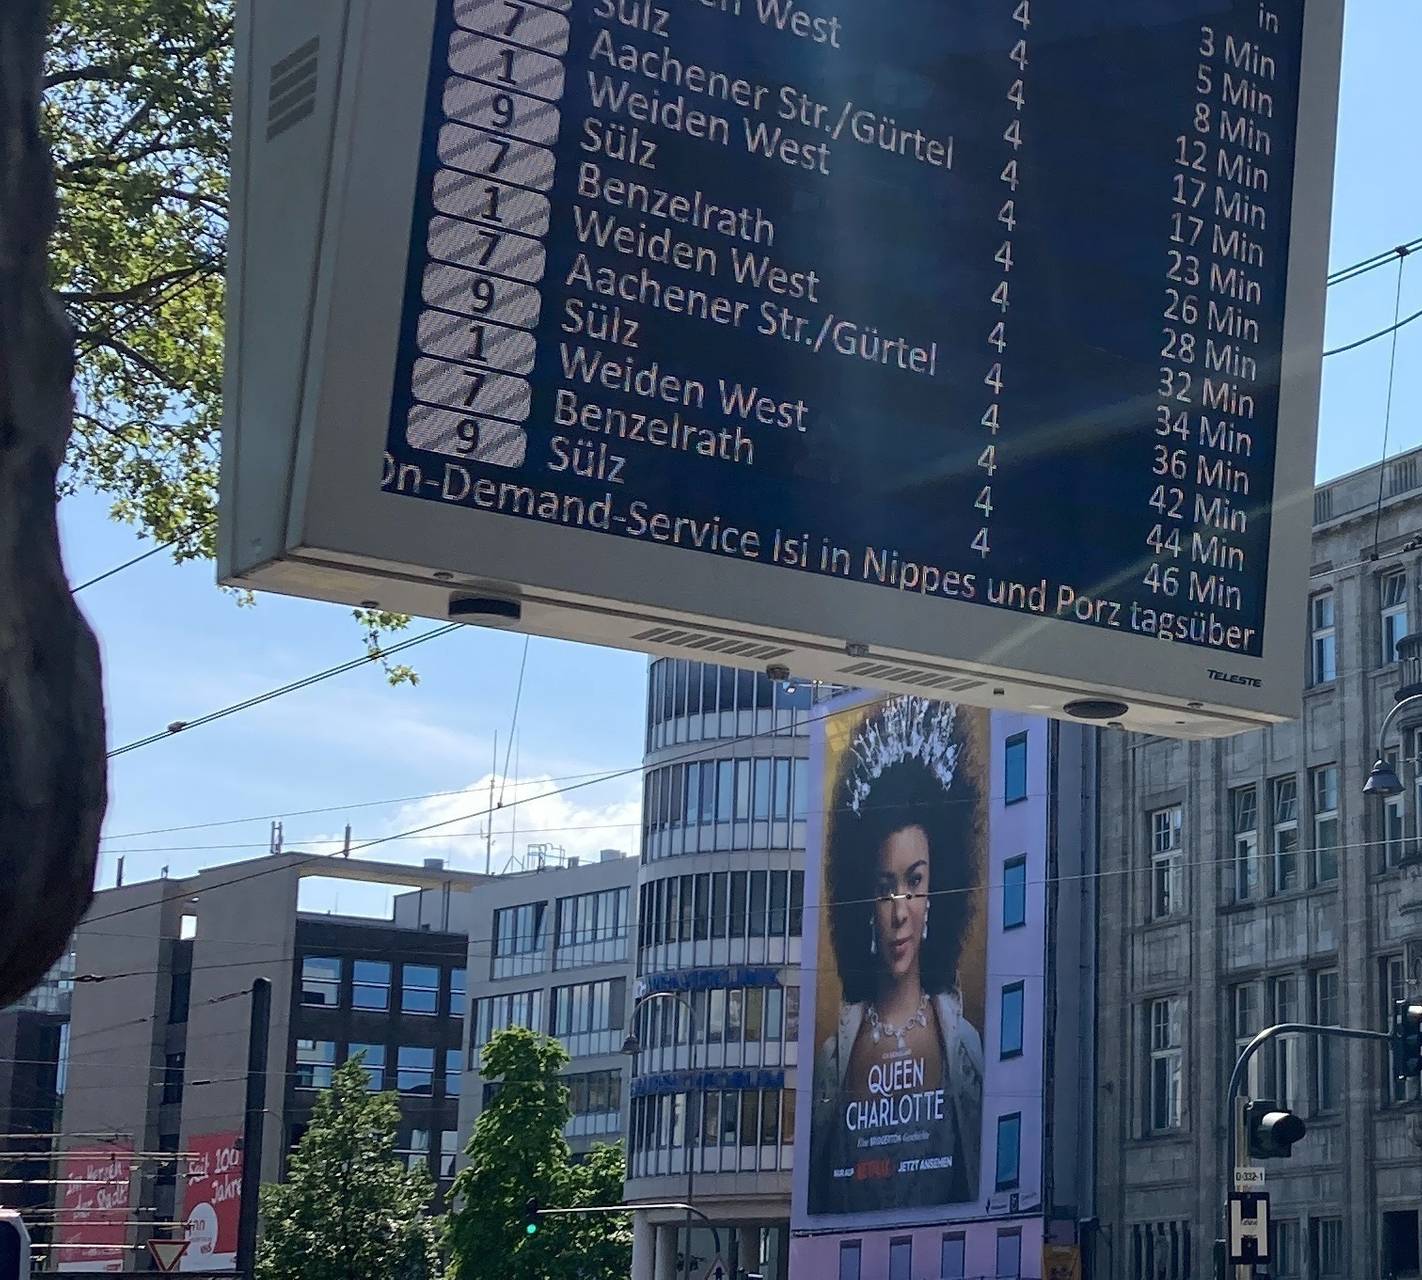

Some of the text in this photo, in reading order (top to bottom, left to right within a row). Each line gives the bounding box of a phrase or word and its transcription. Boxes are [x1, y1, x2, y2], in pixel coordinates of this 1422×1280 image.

[756, 0, 1269, 193] West 4 12 Min
[1009, 38, 1271, 156] 4 8 Min
[1011, 0, 1273, 119] 4 5 Min
[1198, 25, 1276, 81] 3 Min
[1258, 1, 1279, 34] in
[492, 95, 1259, 344] 9 Sülz 4 26 Min
[497, 49, 1262, 306] 1 Weiden West 4 23 Min
[505, 3, 1264, 268] 7 Aachener Str./Gürtel 4 17 Min
[1002, 119, 1023, 151] 4
[1171, 172, 1207, 209] 17
[1214, 185, 1266, 231] Min
[478, 230, 1252, 458] 7 Aachener Str./Gürtel 4 34 Min
[481, 186, 1255, 419] 1 Weiden West 4 32 Min
[489, 139, 1257, 382] 7 Benzelrath 4 28 Min
[463, 371, 1245, 572] 7 Benzelrath 4 44 Min
[469, 325, 1248, 534] 1 Weiden West 4 42 Min
[472, 278, 1250, 496] 9 Sülz 4 36 Min
[456, 418, 1242, 611] 9 Sülz 4 46 Min
[821, 537, 851, 575] in
[863, 546, 976, 599] Nippes
[987, 578, 1047, 612] und
[1057, 584, 1121, 627] Porz
[1130, 600, 1255, 650] tagsüber
[1207, 669, 1263, 687] TELESTE
[214, 1148, 240, 1174] 100
[846, 1090, 944, 1131] CHARLOTTE
[868, 1057, 925, 1097] QUEEN
